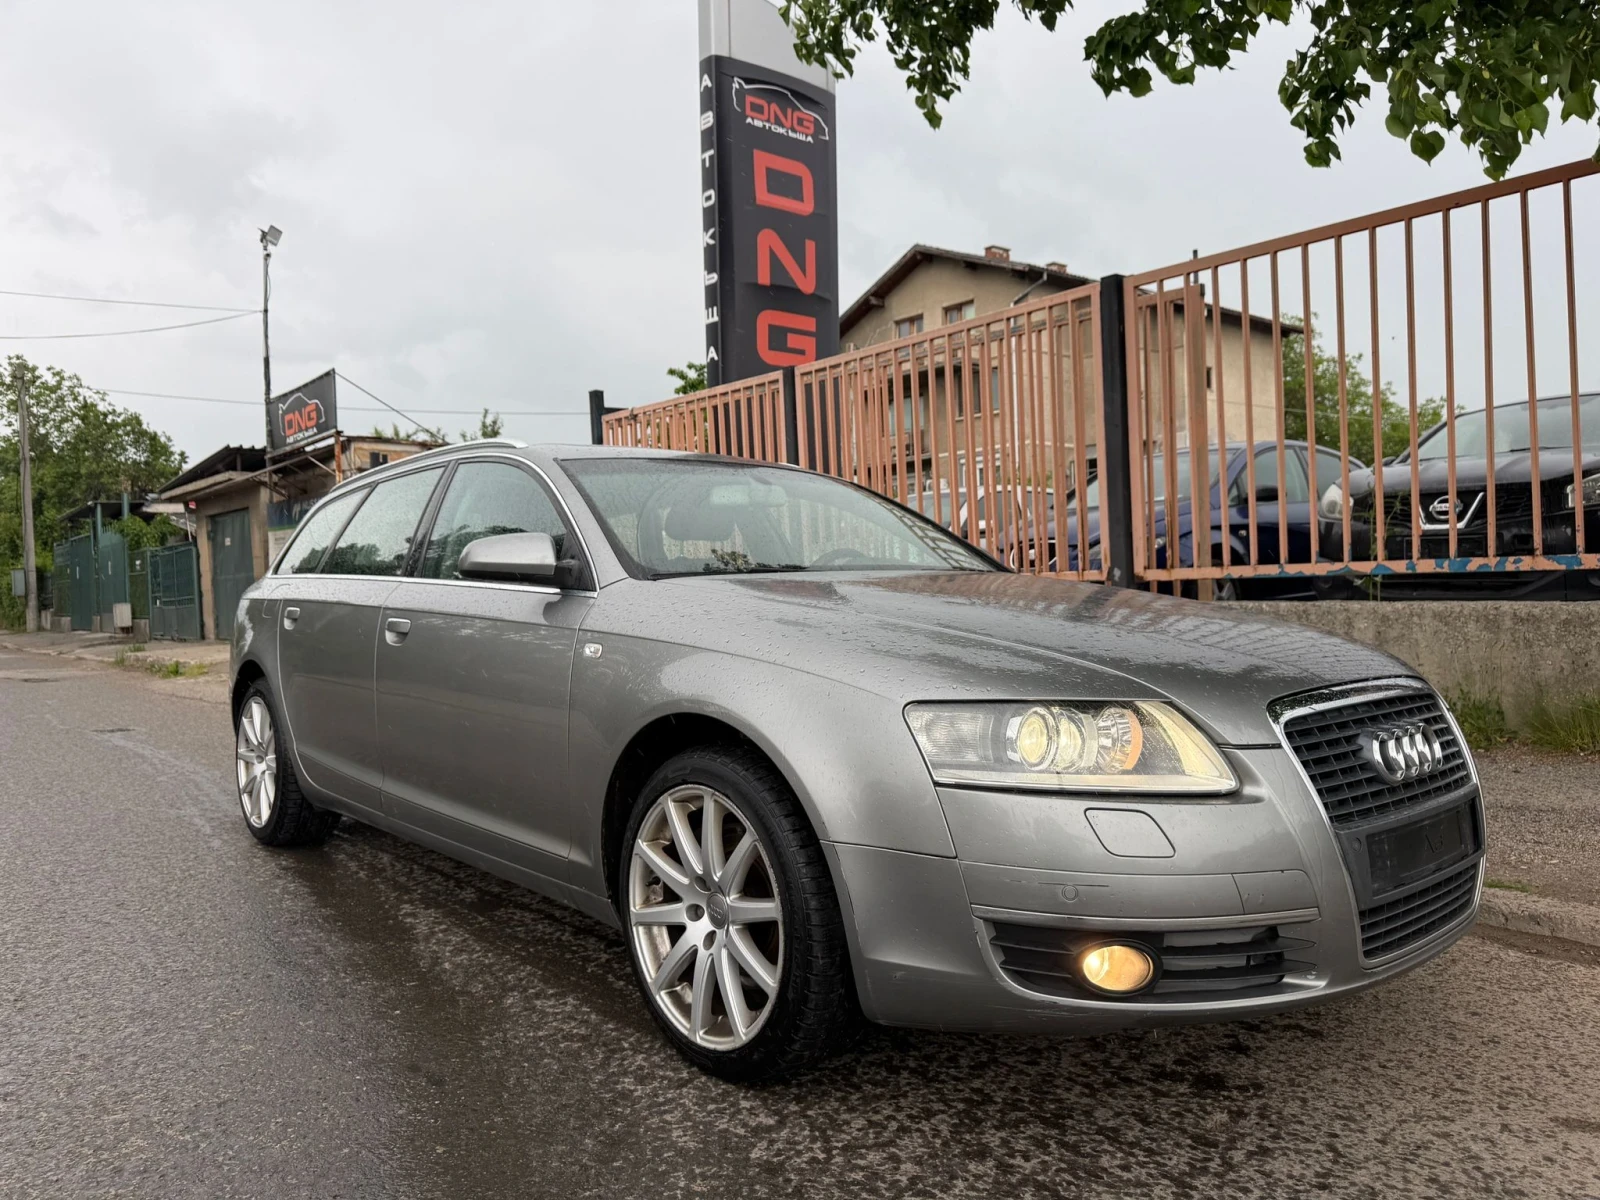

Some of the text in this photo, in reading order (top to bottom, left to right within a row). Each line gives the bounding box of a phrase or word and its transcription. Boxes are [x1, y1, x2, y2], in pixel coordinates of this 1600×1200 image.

[745, 94, 814, 135] DNG
[753, 149, 816, 367] DNG
[284, 403, 317, 436] DNG
